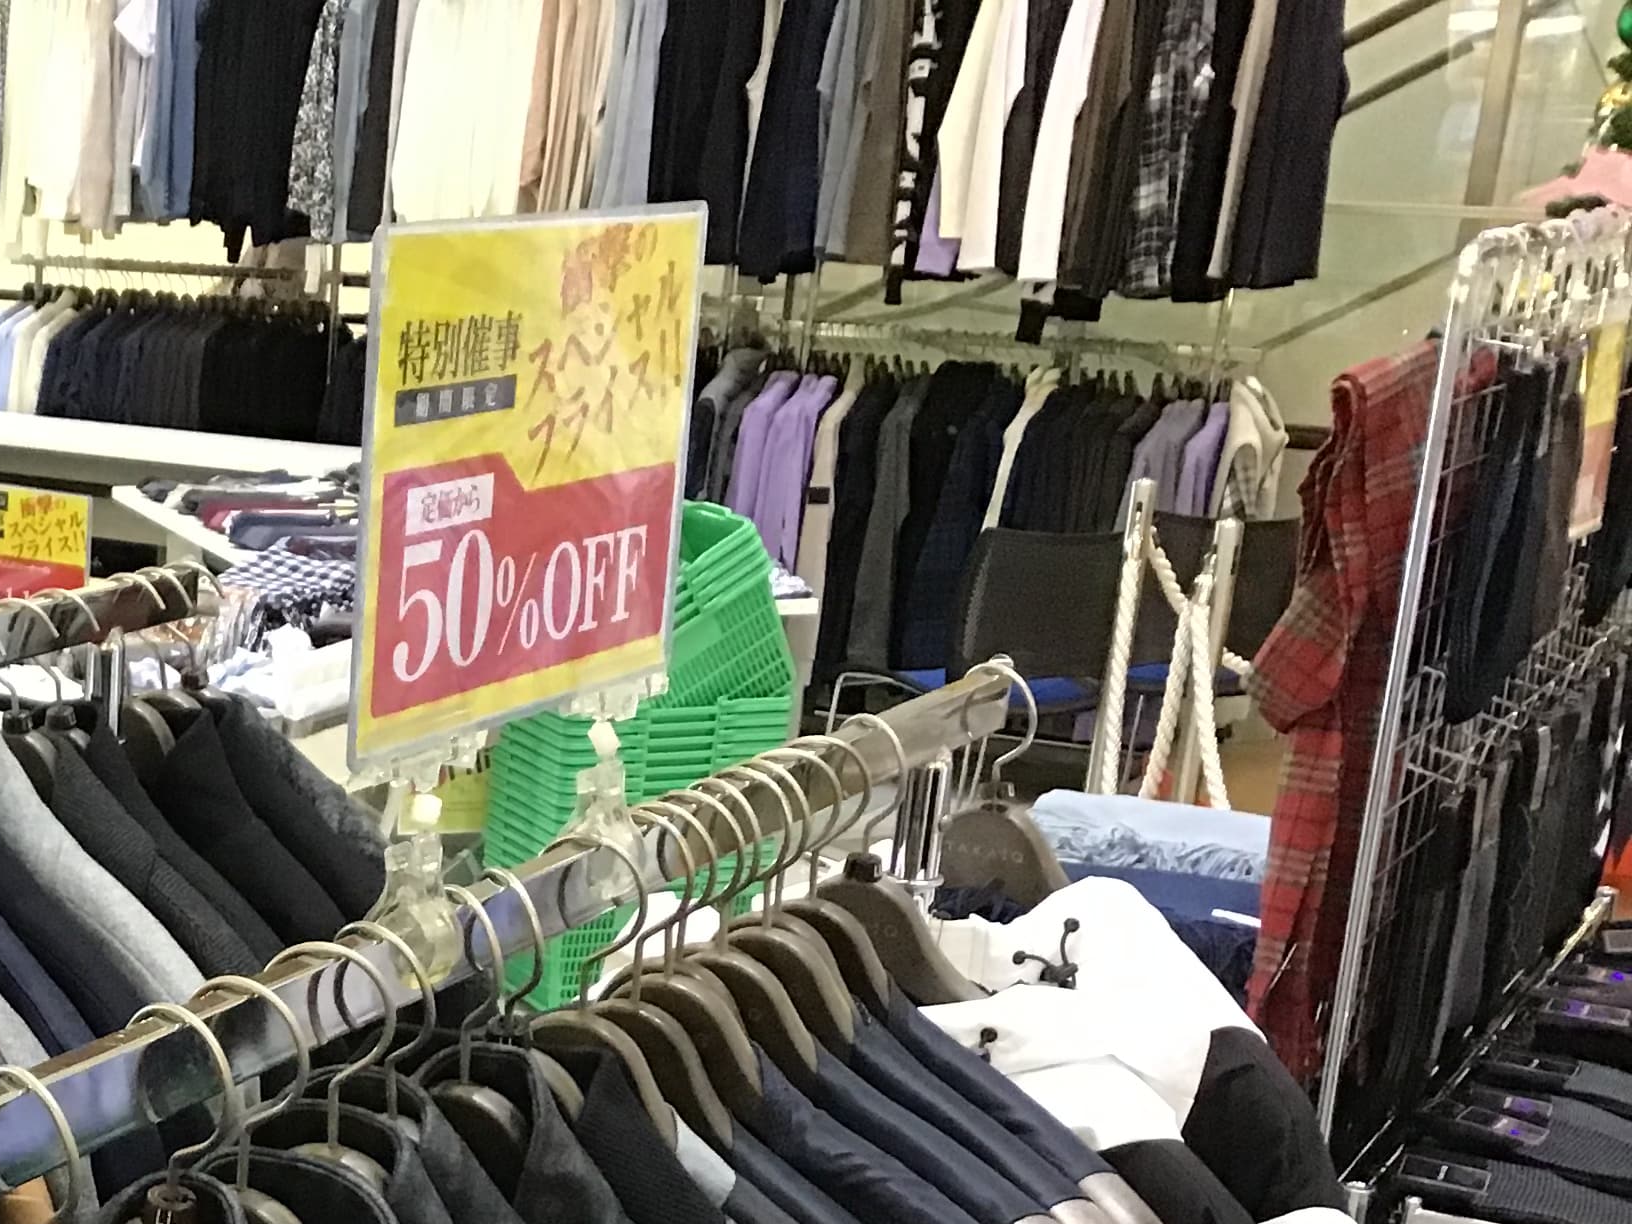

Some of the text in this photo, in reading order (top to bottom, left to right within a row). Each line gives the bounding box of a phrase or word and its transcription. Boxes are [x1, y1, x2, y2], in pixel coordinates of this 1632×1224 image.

[397, 310, 524, 386] 特別催事
[392, 525, 648, 684] 50%OFF
